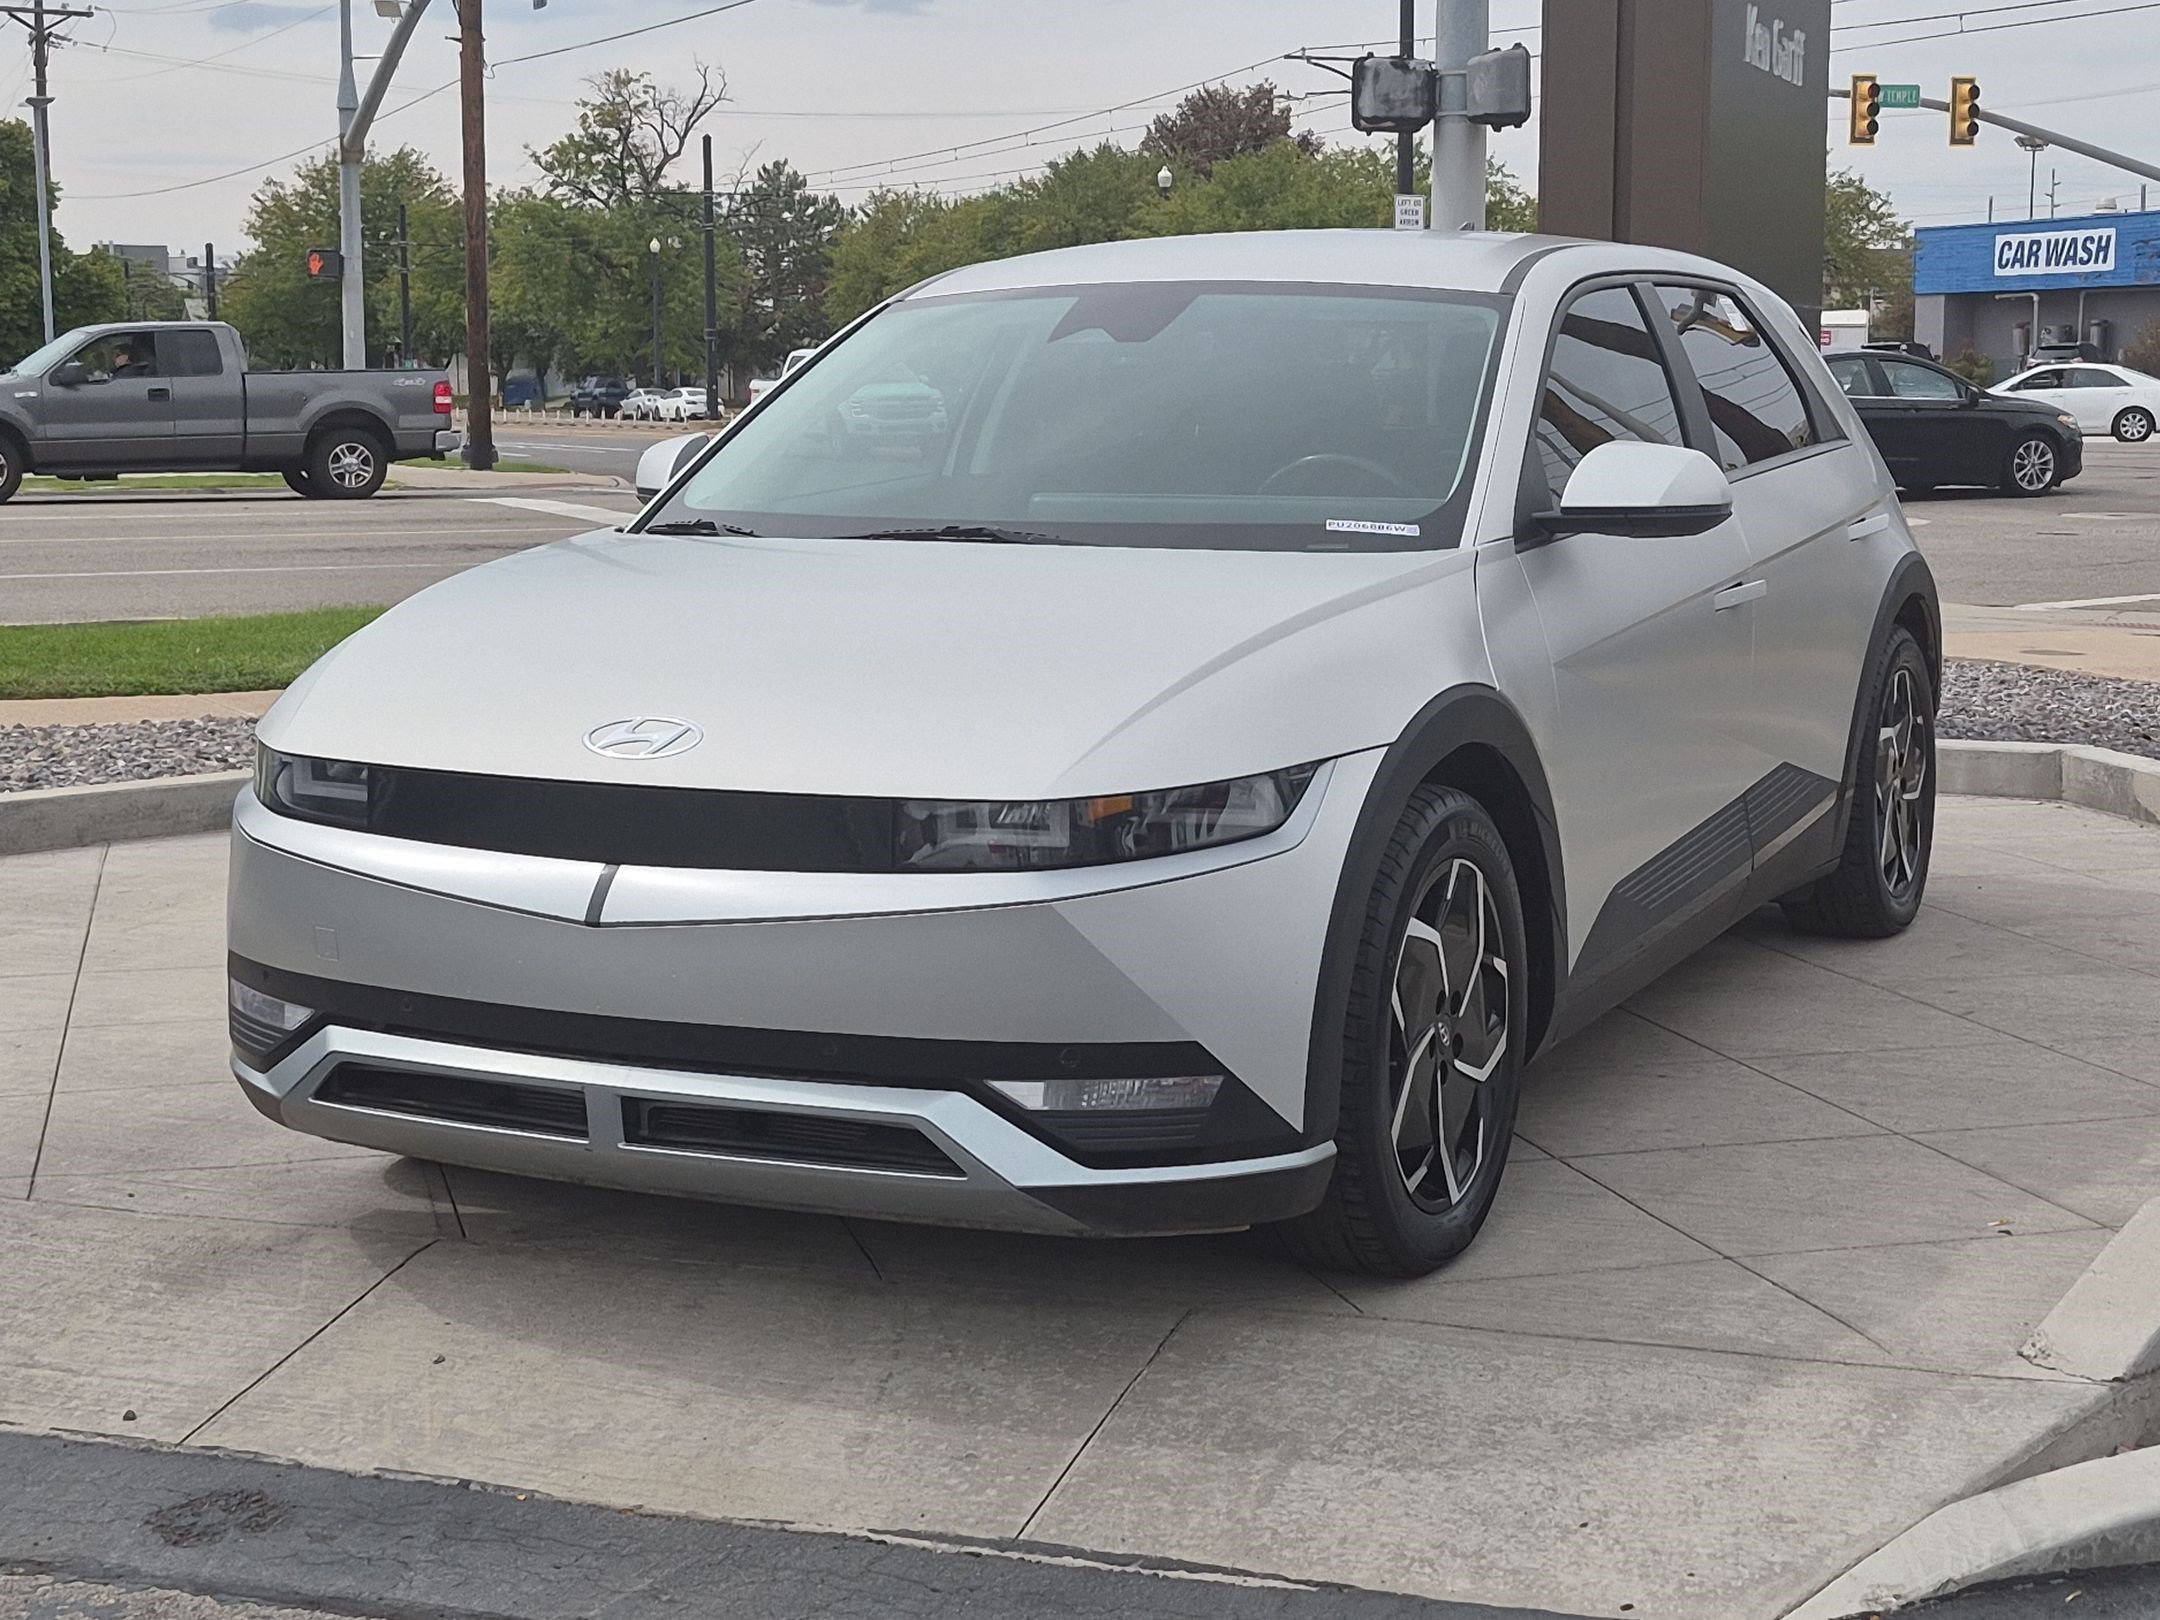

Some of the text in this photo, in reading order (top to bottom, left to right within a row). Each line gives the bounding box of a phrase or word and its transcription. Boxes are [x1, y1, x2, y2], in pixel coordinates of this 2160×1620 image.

[1743, 3, 1770, 72] Ken
[1887, 90, 1917, 103] TEMPLE
[1997, 234, 2112, 270] CAR WASH
